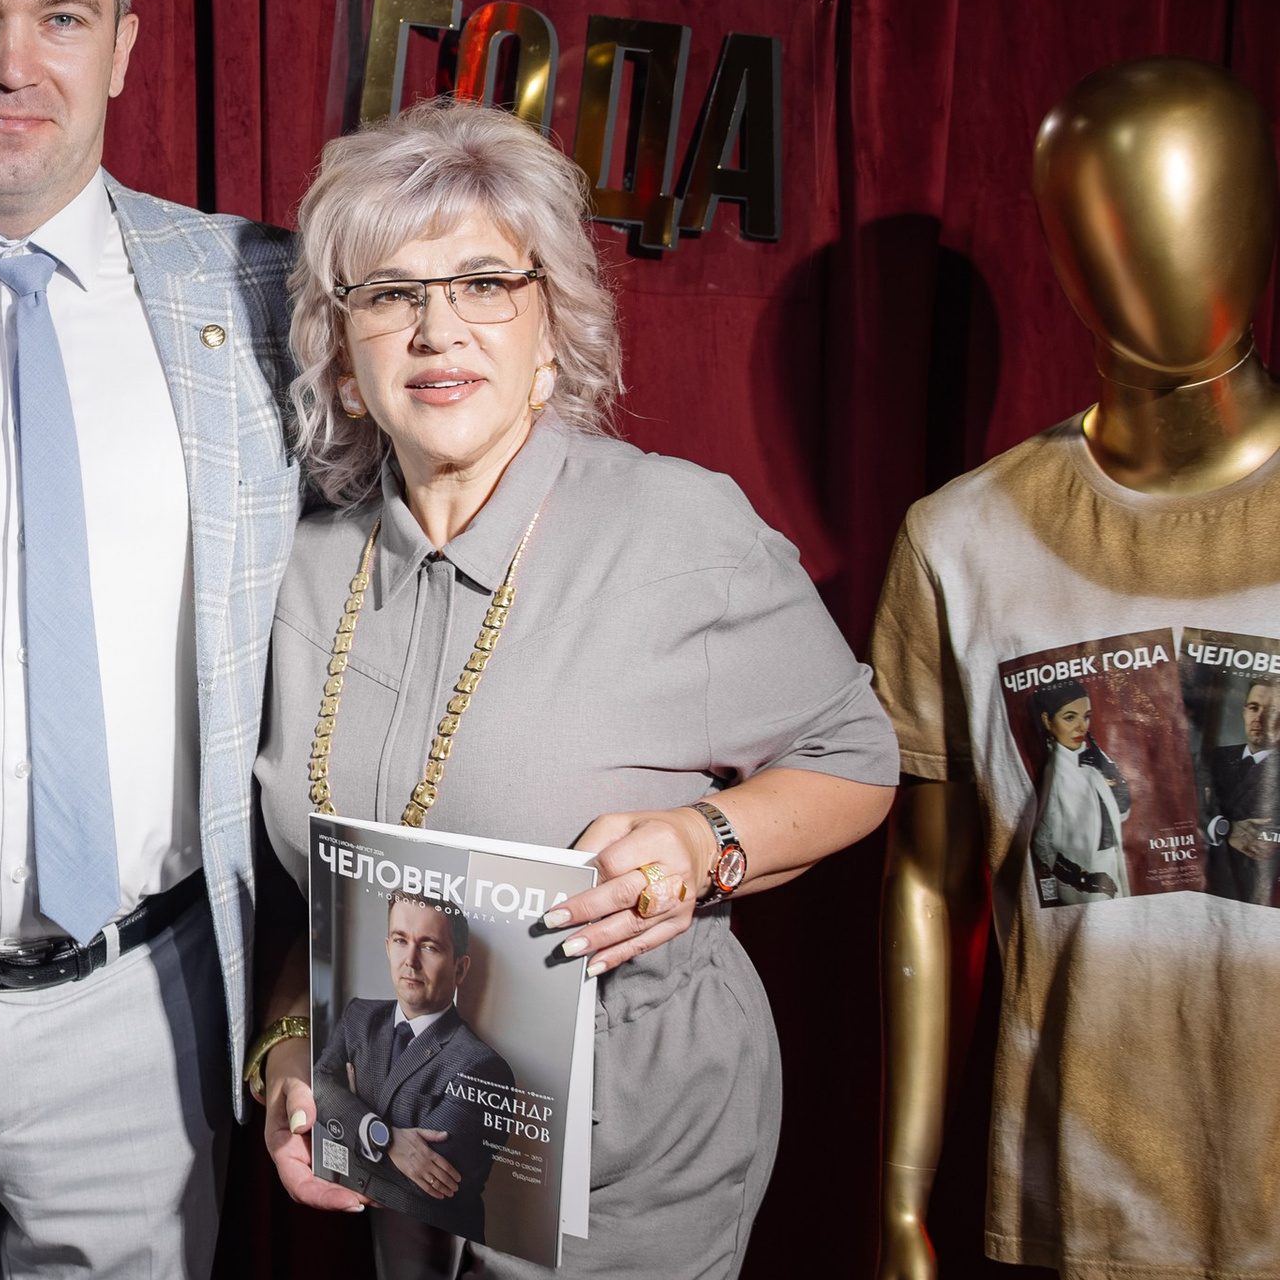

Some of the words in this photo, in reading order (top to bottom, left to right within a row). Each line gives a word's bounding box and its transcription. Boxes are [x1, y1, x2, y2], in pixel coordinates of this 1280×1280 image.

[1003, 655, 1098, 693] ЧЕЛОВЕК
[1102, 644, 1170, 671] ГОДА
[1149, 834, 1195, 850] ЮЛИЯ
[1161, 848, 1198, 862] ТЮС
[319, 842, 465, 905] ЧЕЛОВЕК
[377, 891, 426, 908] НОВОГО
[434, 905, 496, 923] ФОРМАТА
[444, 1081, 553, 1122] АЛЕКСАНДР
[483, 1111, 551, 1143] ВЕТРОВ
